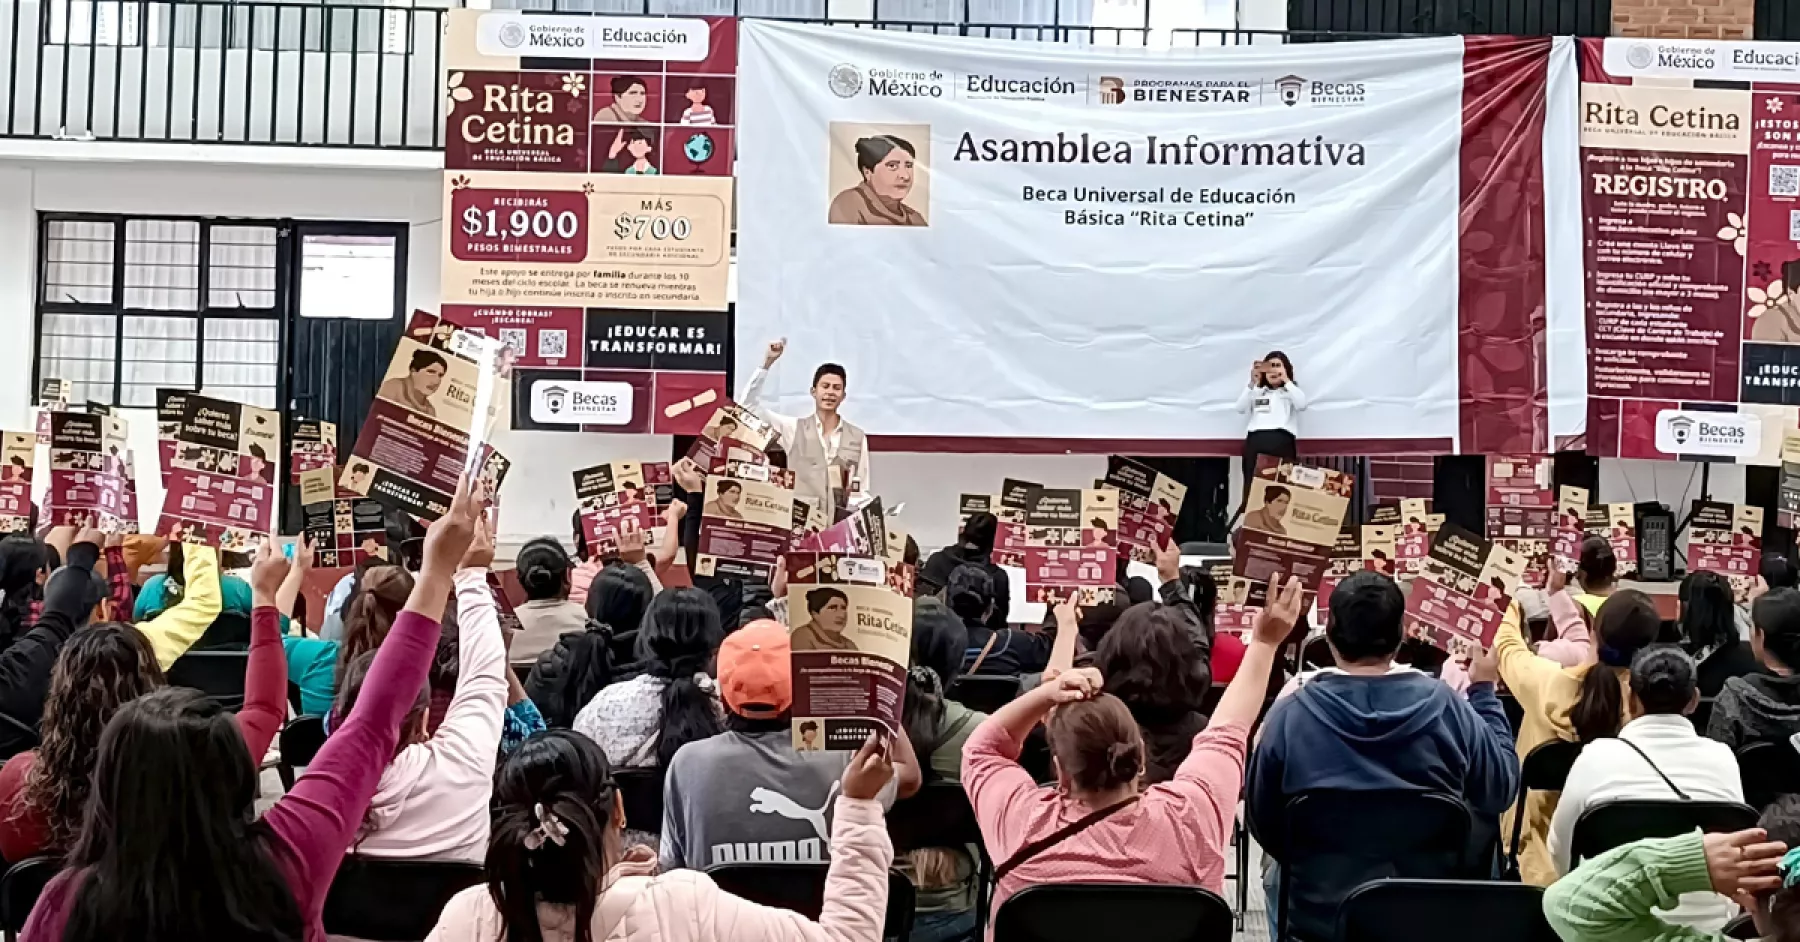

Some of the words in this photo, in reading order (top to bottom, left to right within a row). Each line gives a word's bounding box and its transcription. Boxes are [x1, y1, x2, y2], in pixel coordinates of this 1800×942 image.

[529, 32, 585, 47] México
[602, 27, 687, 44] Educación
[1658, 45, 1701, 54] Gobierno
[1705, 46, 1716, 55] de
[1732, 49, 1799, 66] Educaci
[1658, 54, 1715, 70] México
[868, 68, 925, 80] Gobierno
[929, 70, 943, 80] de
[868, 78, 943, 97] México
[966, 74, 1076, 94] Educación
[1133, 80, 1204, 88] PROGRAMAS
[1206, 80, 1235, 88] PARA
[1237, 80, 1250, 88] EL
[1310, 81, 1366, 96] Becas
[483, 84, 554, 114] Rita
[1133, 89, 1250, 103] BIENESTAR
[1584, 102, 1639, 125] Rita
[1650, 104, 1740, 130] Cetina
[461, 114, 575, 146] Cetina
[1755, 120, 1799, 130] ¡ESTOS
[1764, 132, 1792, 141] SON
[953, 132, 1132, 164] Asamblea
[1145, 134, 1366, 166] Informativa
[493, 196, 549, 208] RECIBIRÁS
[1022, 186, 1068, 202] Beca
[1073, 186, 1165, 203] Universal
[1170, 188, 1194, 204] de
[1199, 188, 1296, 205] Educación
[640, 198, 674, 212] MÁS
[462, 205, 579, 242] $1,900
[1064, 208, 1125, 226] Básica
[614, 212, 692, 240] $700
[467, 242, 500, 253] PESOS
[503, 243, 573, 254] BIMESTRALES
[480, 267, 499, 276] Este
[501, 269, 527, 278] apoyo
[540, 269, 574, 280] entrega
[576, 270, 591, 279] por
[593, 270, 626, 279] familia
[628, 271, 662, 280] durante
[664, 272, 677, 280] los
[679, 272, 690, 280] 10
[472, 278, 500, 286] meses
[575, 280, 586, 288] La
[621, 282, 656, 290] renueva
[658, 283, 696, 291] mientras
[523, 288, 562, 296] continúe
[474, 308, 514, 317] ¿CUÁNDO
[608, 325, 680, 339] ¡EDUCAR
[687, 326, 706, 339] ES
[590, 340, 722, 356] TRANSFORMAR!
[1758, 364, 1798, 376] ¡EDUC
[572, 391, 618, 406] Becas
[1699, 422, 1745, 438] Becas
[857, 612, 882, 628] Rita
